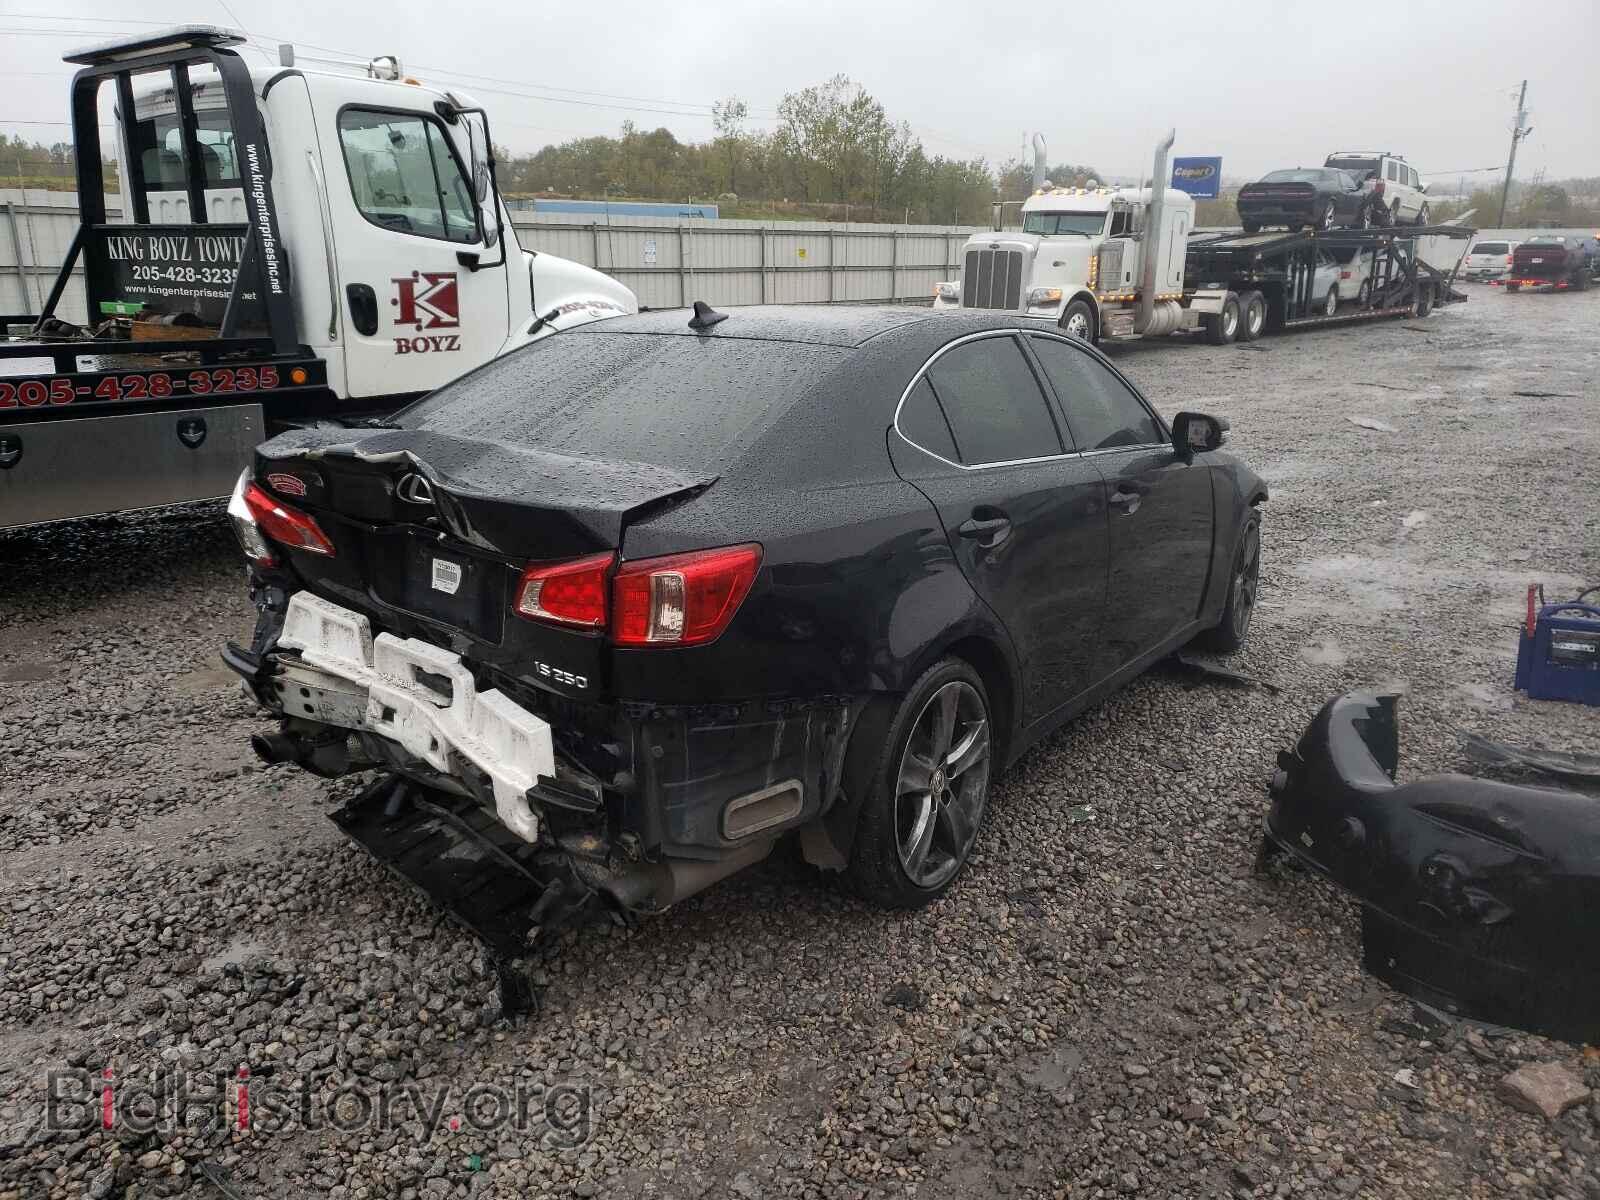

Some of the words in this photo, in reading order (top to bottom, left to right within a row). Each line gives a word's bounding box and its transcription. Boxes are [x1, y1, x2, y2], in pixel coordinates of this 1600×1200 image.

[107, 236, 144, 260] KING
[149, 236, 192, 261] BOYZ
[392, 334, 462, 355] BOYZ
[0, 367, 280, 409] 205-428-3235
[534, 661, 551, 677] IS
[552, 668, 588, 688] 250
